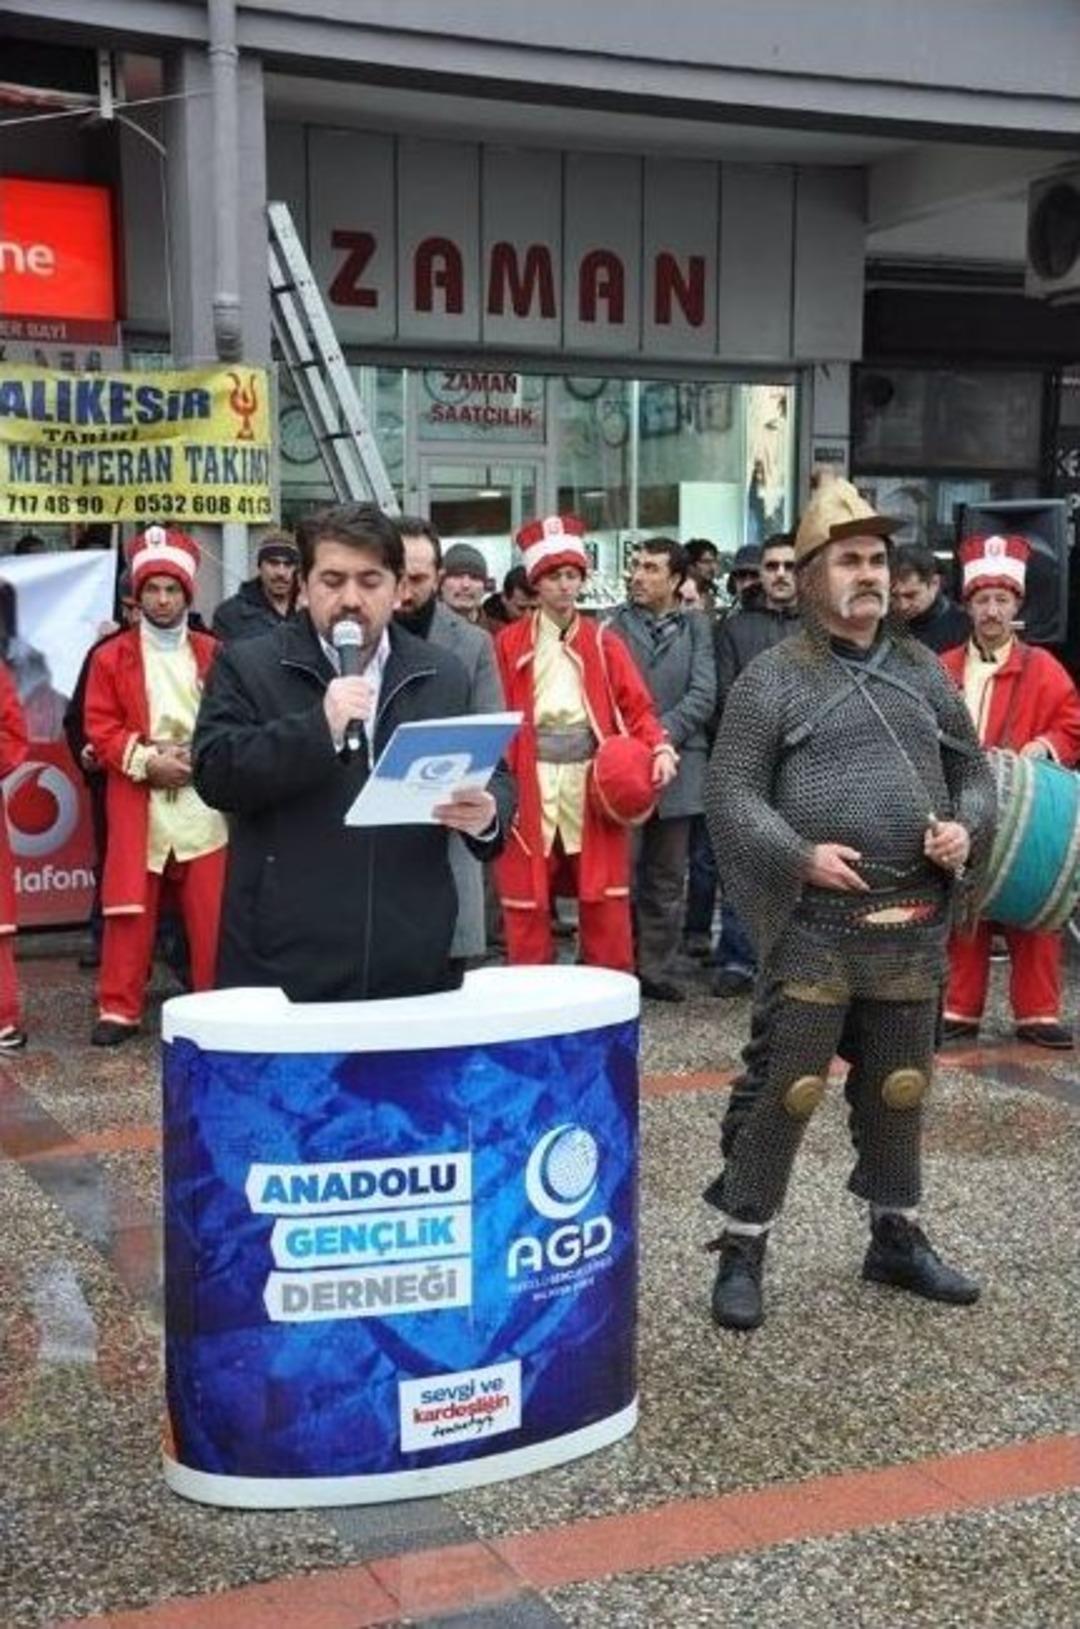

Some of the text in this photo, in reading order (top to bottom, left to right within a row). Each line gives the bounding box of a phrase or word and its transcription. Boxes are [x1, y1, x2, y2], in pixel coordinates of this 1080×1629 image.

[328, 229, 706, 327] ZAMAN
[441, 372, 518, 394] ZAMAN
[8, 445, 173, 486] MEHTERAN
[7, 493, 38, 513] 717
[134, 494, 186, 514] 0532
[193, 496, 231, 515] 608
[261, 1163, 457, 1204] ANADOLU
[507, 1215, 613, 1278] AGD
[421, 1378, 504, 1404] sevgi ve
